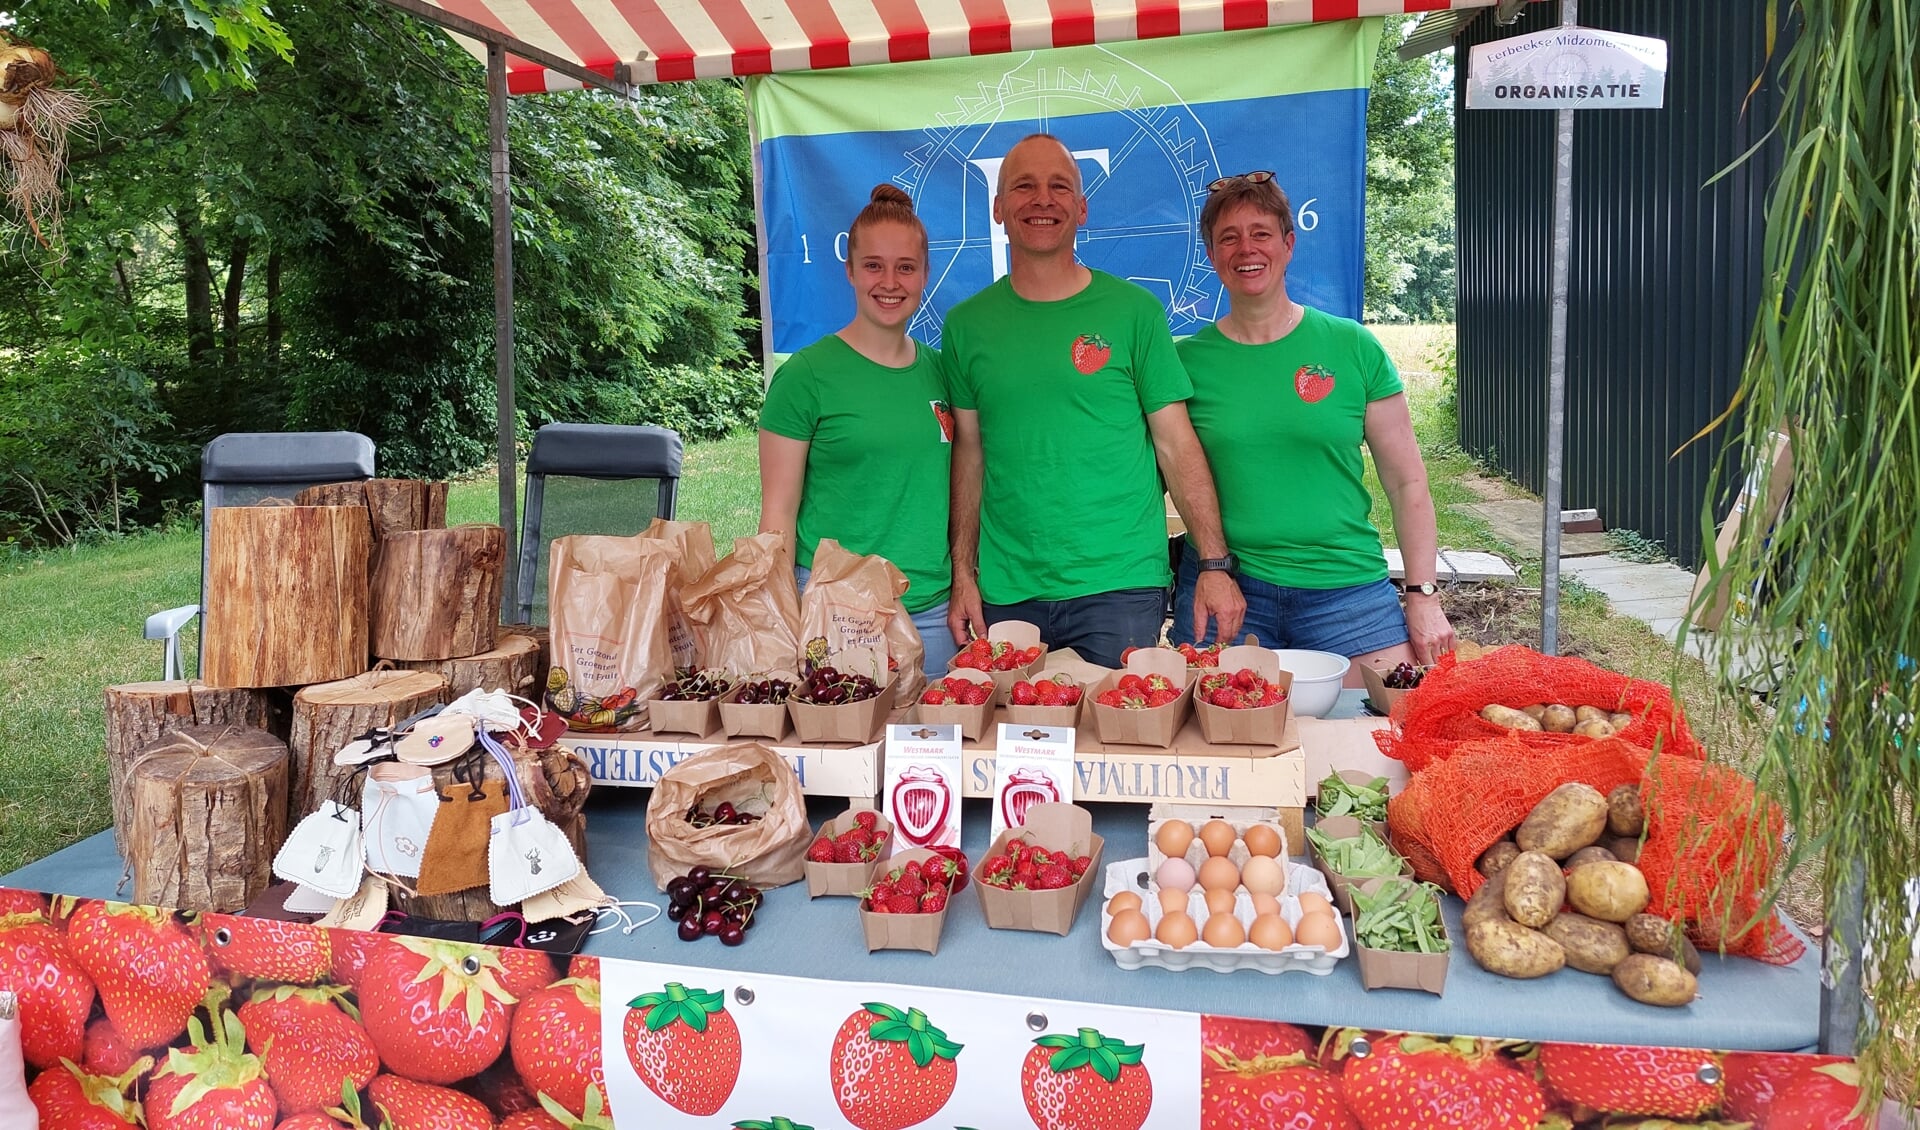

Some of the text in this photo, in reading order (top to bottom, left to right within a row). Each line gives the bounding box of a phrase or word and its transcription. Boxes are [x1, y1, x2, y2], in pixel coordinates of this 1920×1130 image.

[1494, 83, 1641, 100] ORGANISATIE
[570, 644, 618, 660] Eet Gezond
[576, 657, 617, 671] Groenten
